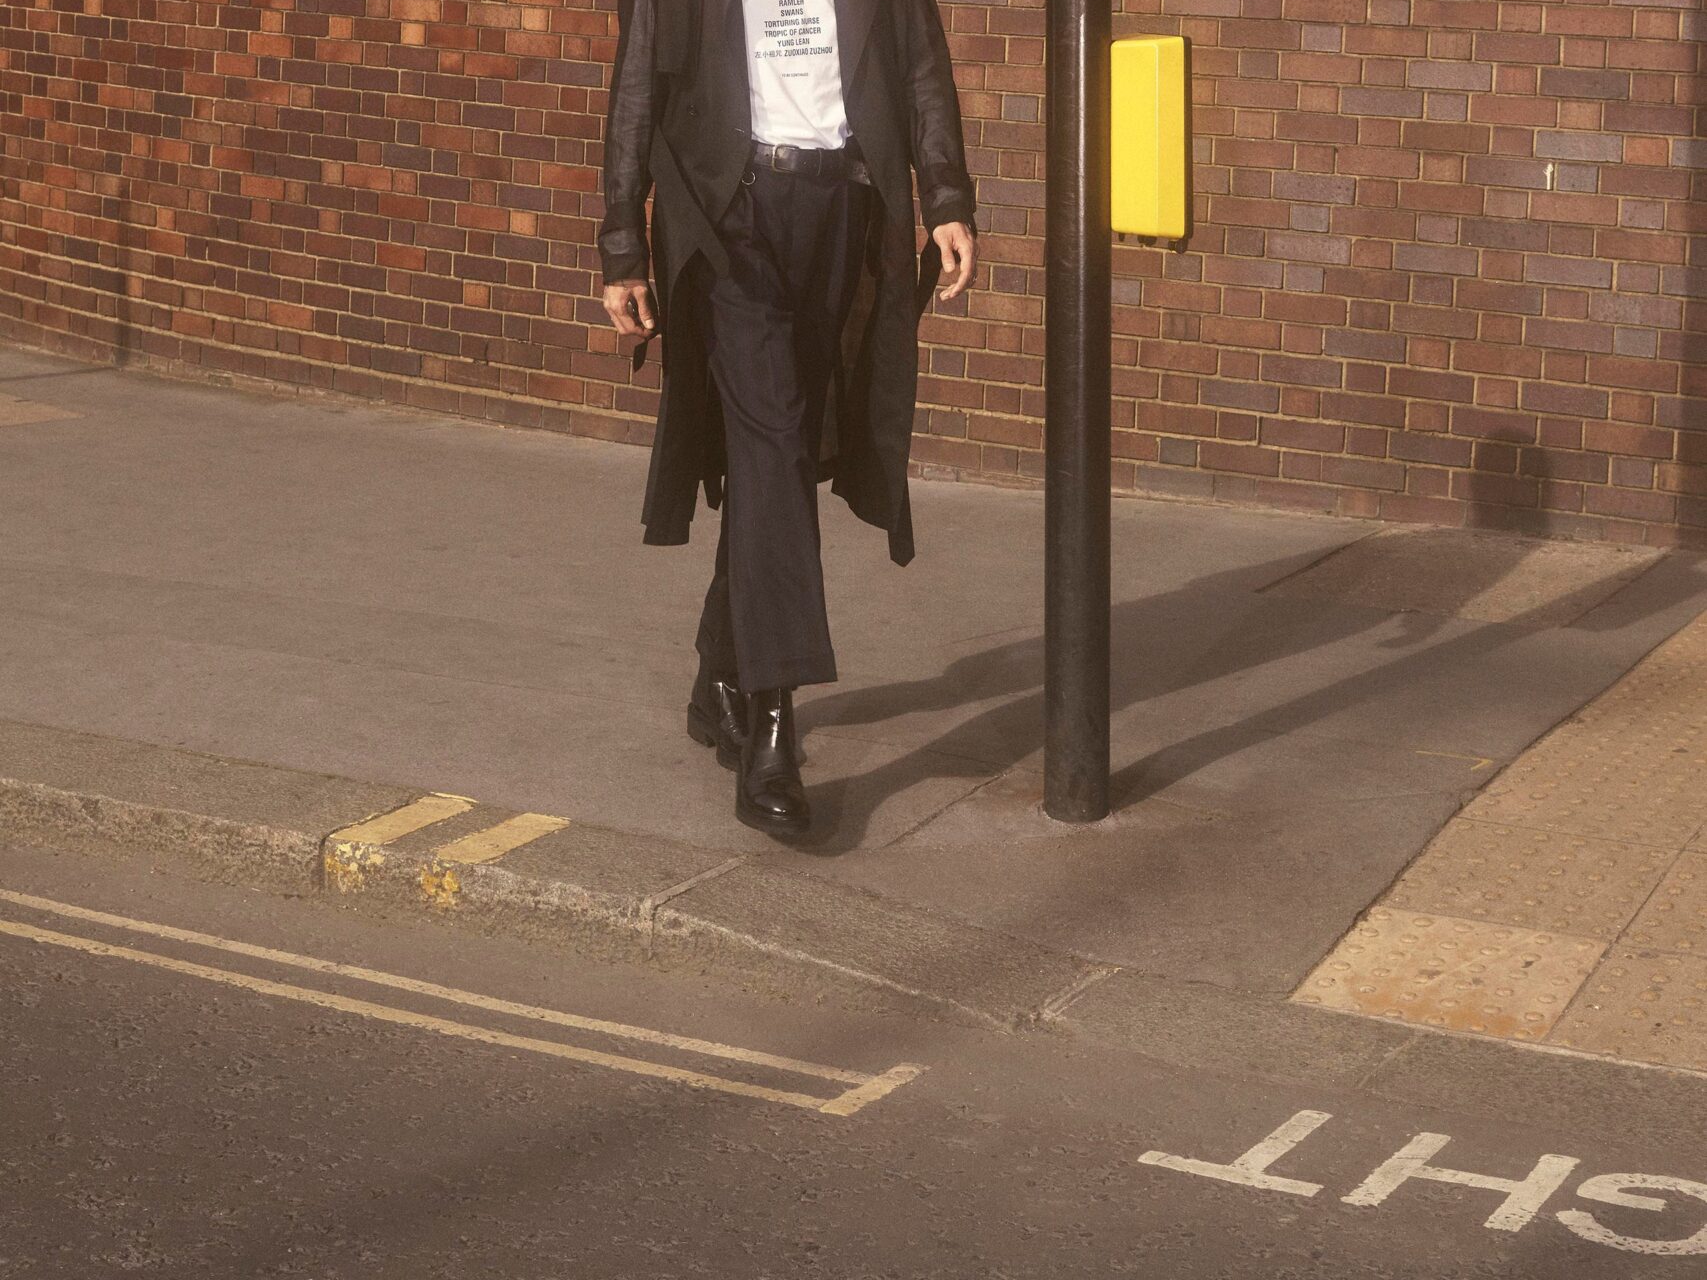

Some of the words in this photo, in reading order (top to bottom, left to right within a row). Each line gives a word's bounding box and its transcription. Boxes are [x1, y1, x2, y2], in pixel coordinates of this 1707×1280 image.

[779, 0, 804, 7] RAMLEH
[780, 8, 804, 17] SWANS
[765, 19, 800, 28] TORTURING
[801, 17, 820, 25] NURSE
[765, 29, 788, 38] TROPIC
[799, 27, 821, 35] CANCER
[777, 39, 795, 47] YUNG
[796, 38, 810, 46] LEAN
[784, 48, 809, 56] ZUOXIAO
[810, 47, 833, 55] ZUZHOU
